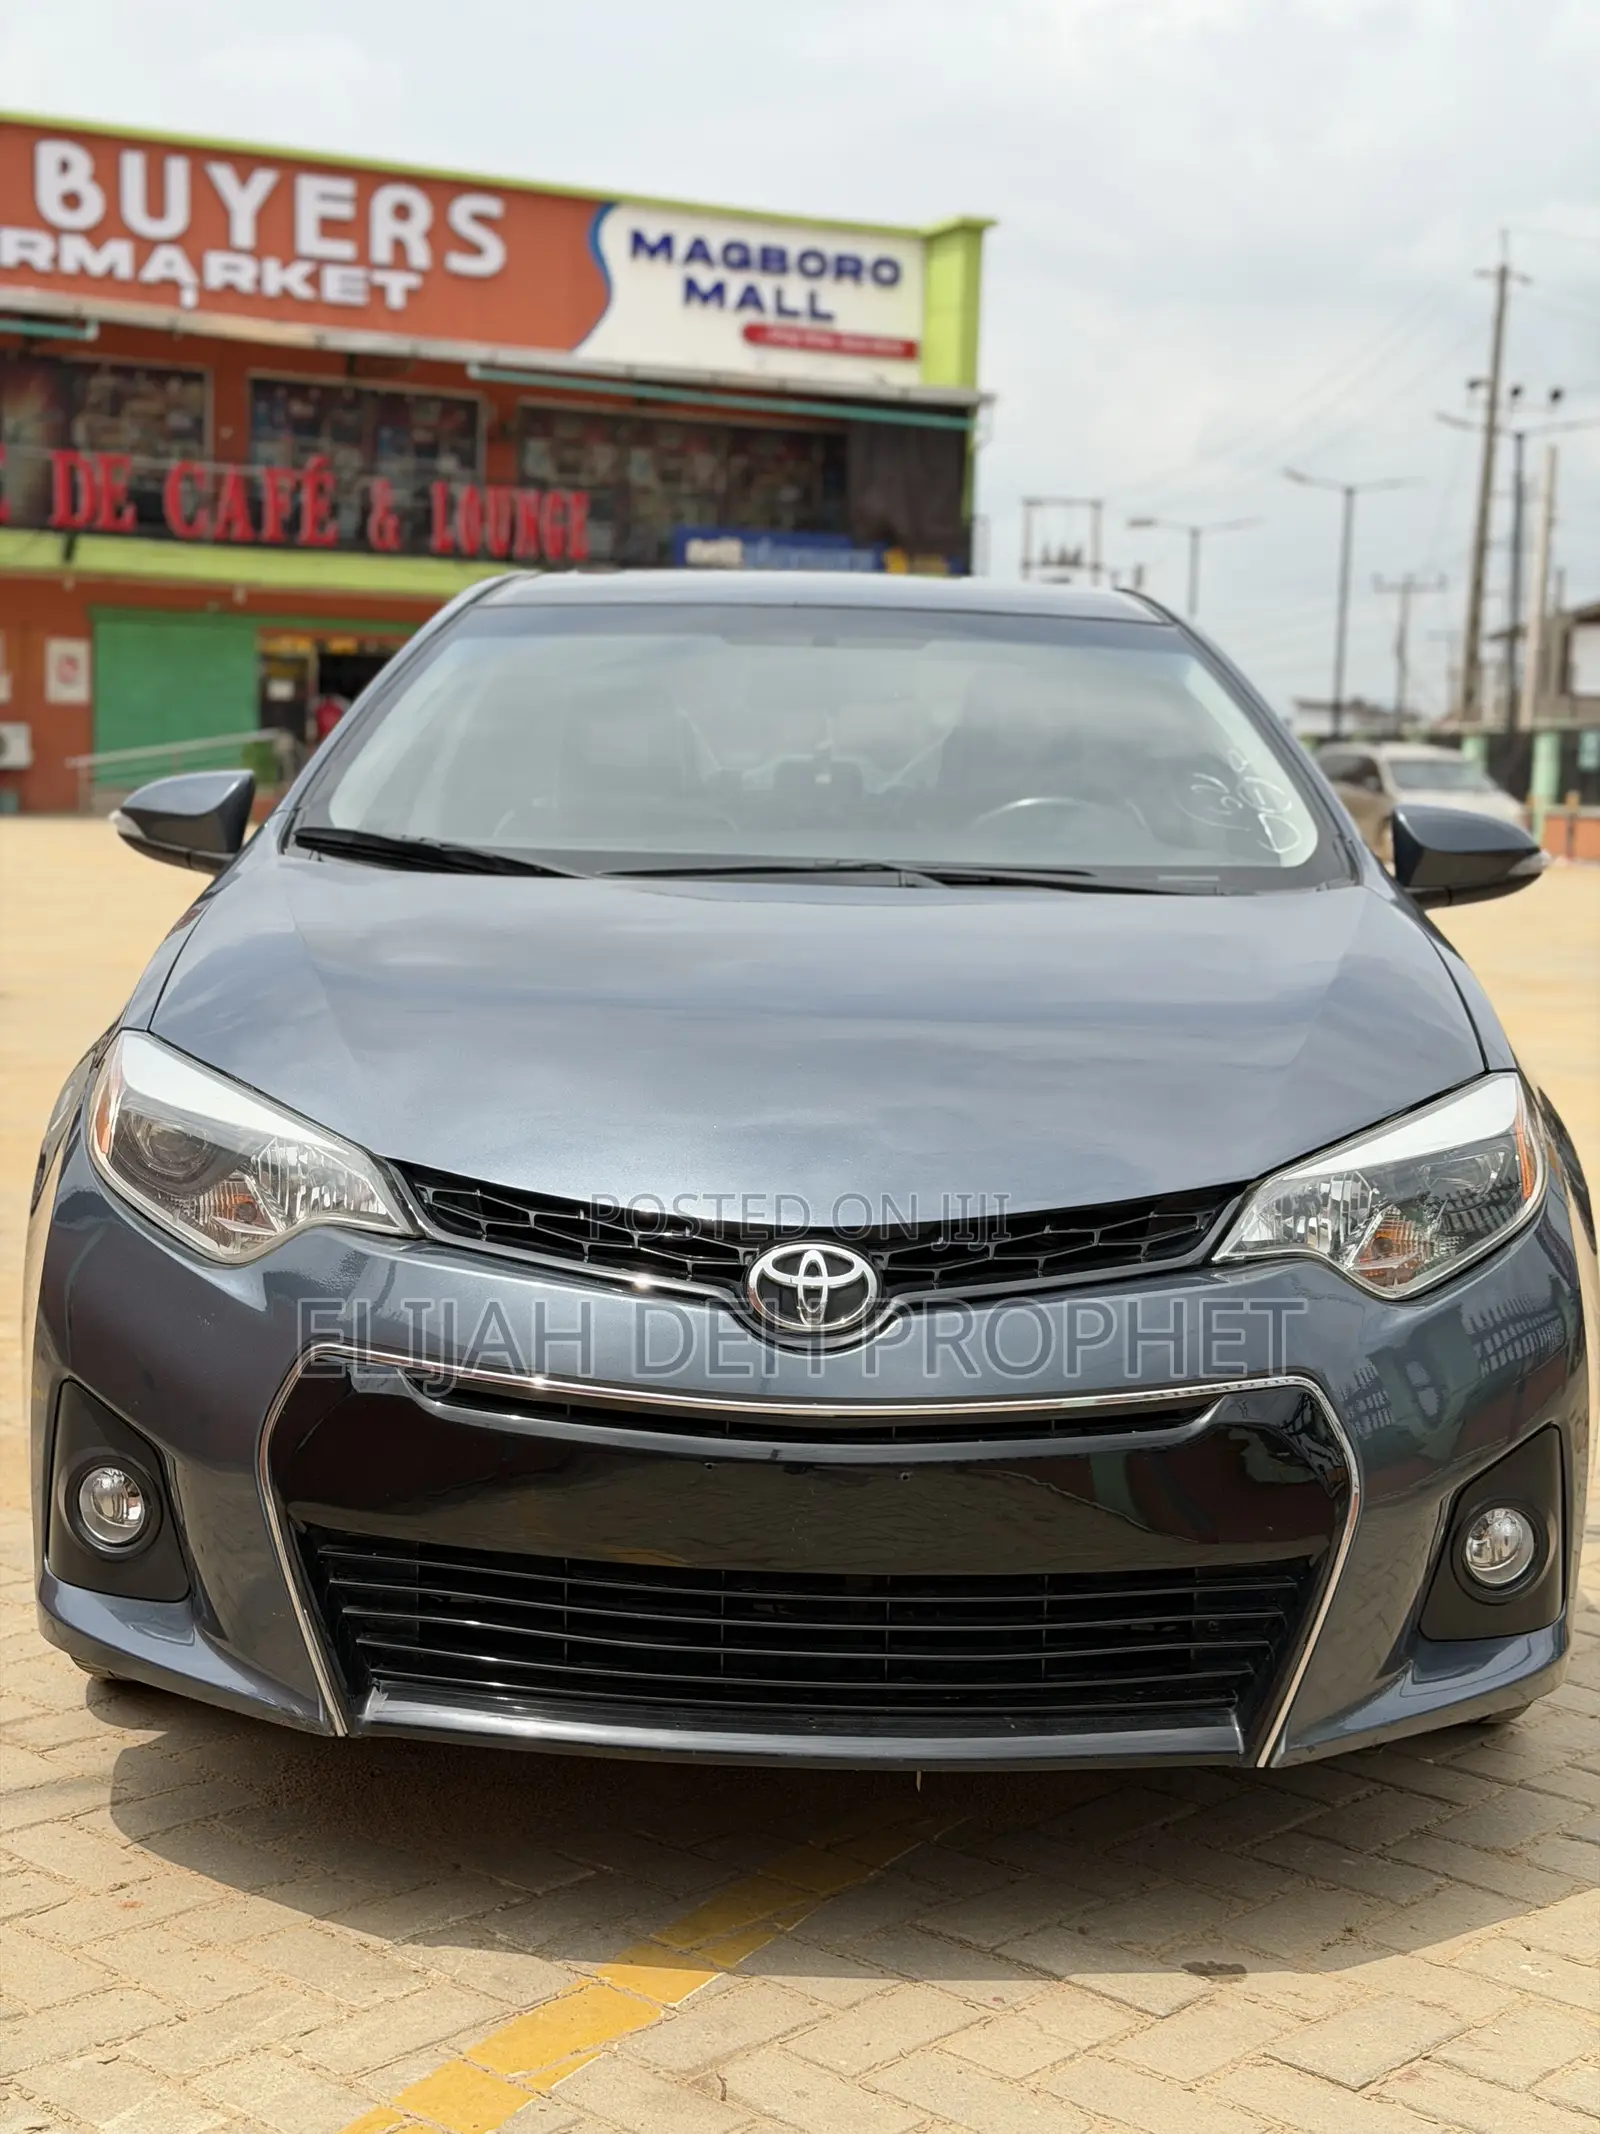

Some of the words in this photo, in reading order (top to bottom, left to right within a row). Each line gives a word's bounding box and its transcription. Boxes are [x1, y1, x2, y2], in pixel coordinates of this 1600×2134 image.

[34, 138, 507, 279] BUYERS
[631, 229, 901, 289] MAGBORO
[683, 276, 834, 322] MALL
[50, 449, 139, 533] DE
[162, 454, 338, 548] CAFÉ
[431, 480, 591, 561] LOUNGE
